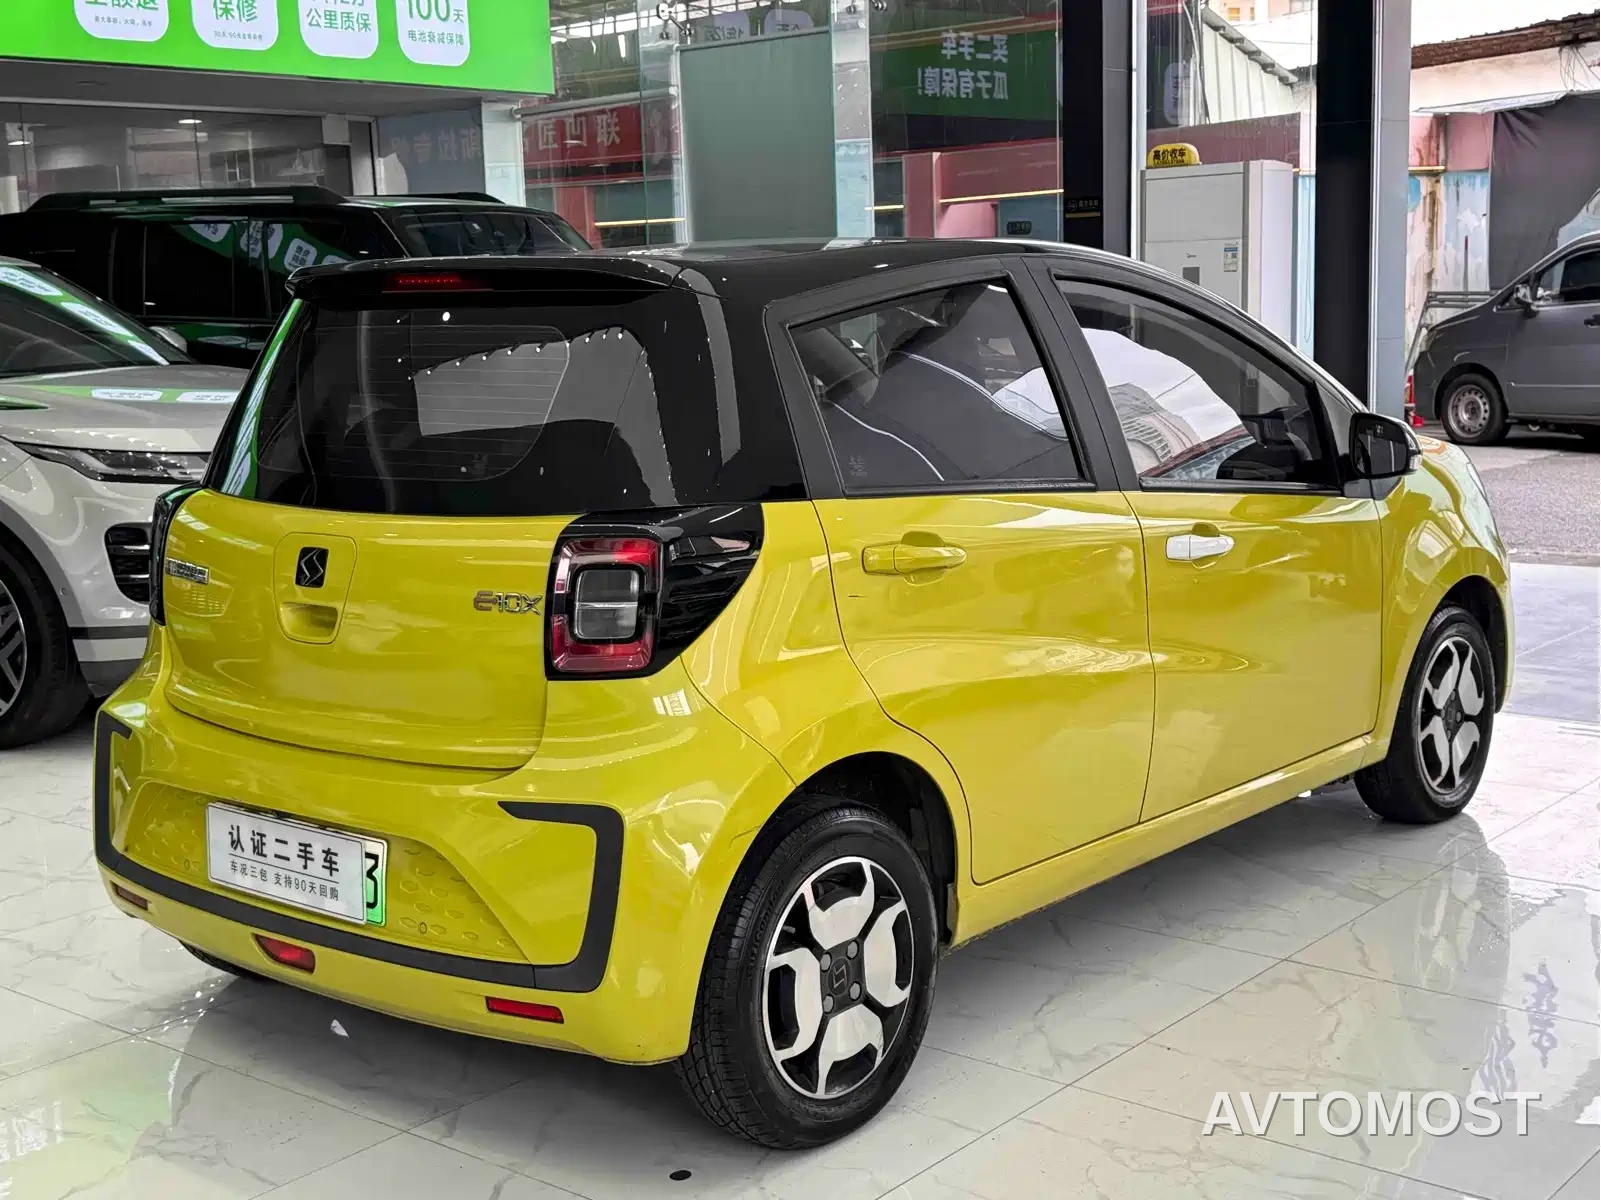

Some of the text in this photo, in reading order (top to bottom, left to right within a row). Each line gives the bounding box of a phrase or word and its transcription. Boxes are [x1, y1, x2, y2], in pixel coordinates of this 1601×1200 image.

[212, 0, 258, 22] 保修
[306, 7, 372, 33] 公里质保
[473, 590, 543, 616] E10X
[228, 824, 340, 877] 认证二手车
[230, 859, 340, 902] 车况三包 支持90天回购
